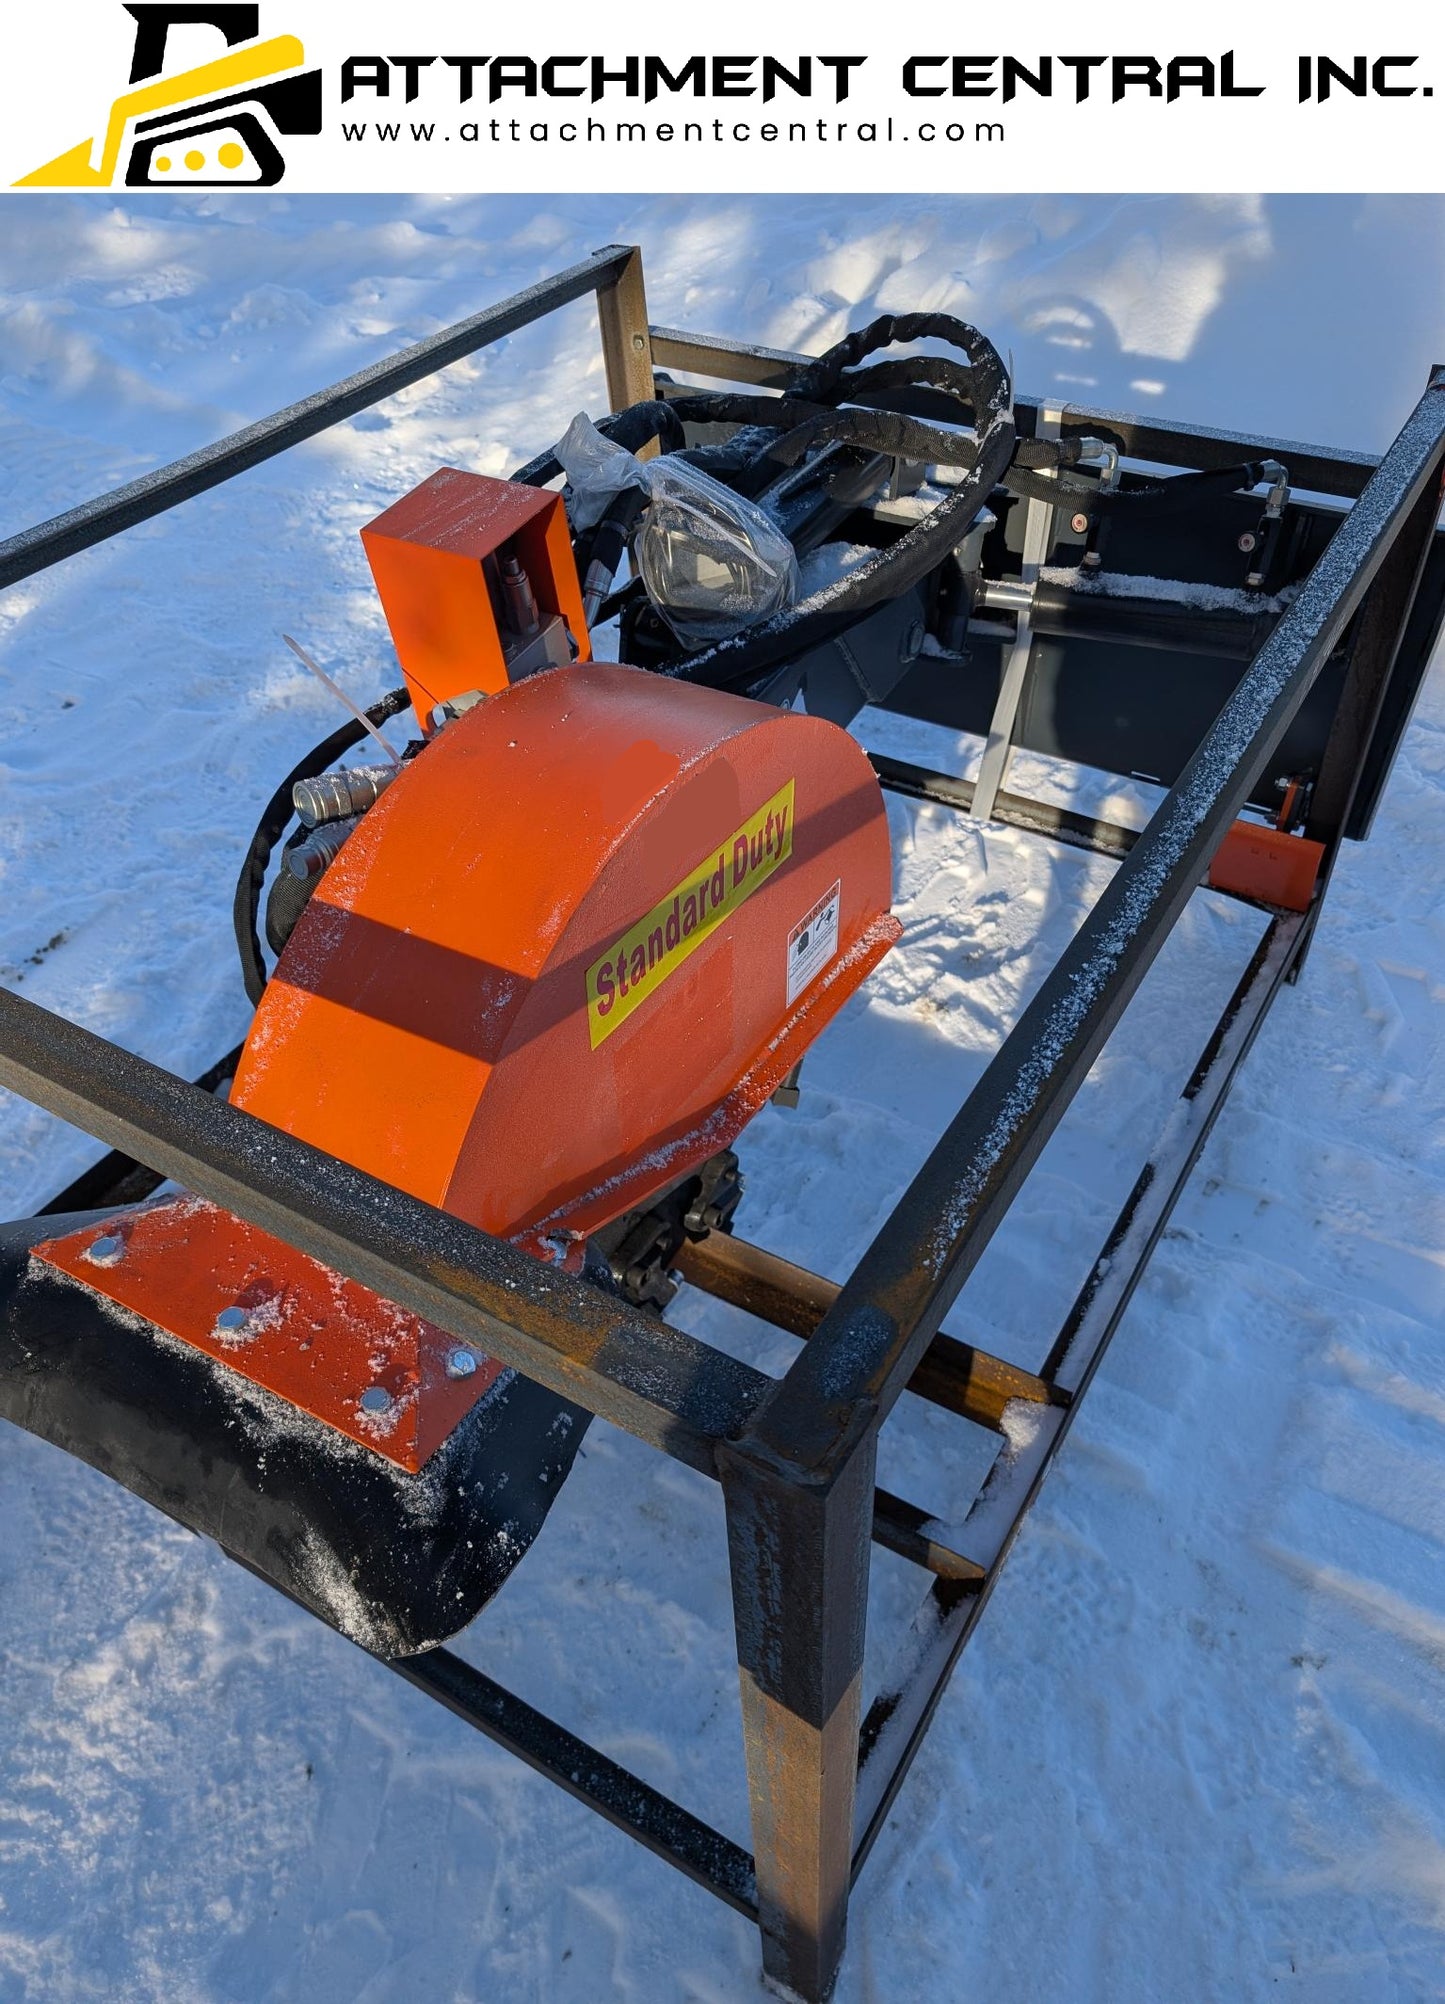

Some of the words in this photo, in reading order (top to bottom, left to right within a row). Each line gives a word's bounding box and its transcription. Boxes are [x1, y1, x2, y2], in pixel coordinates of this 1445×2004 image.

[596, 852, 725, 1016] Standard
[732, 804, 788, 890] Duty
[800, 886, 837, 930] WARNING
